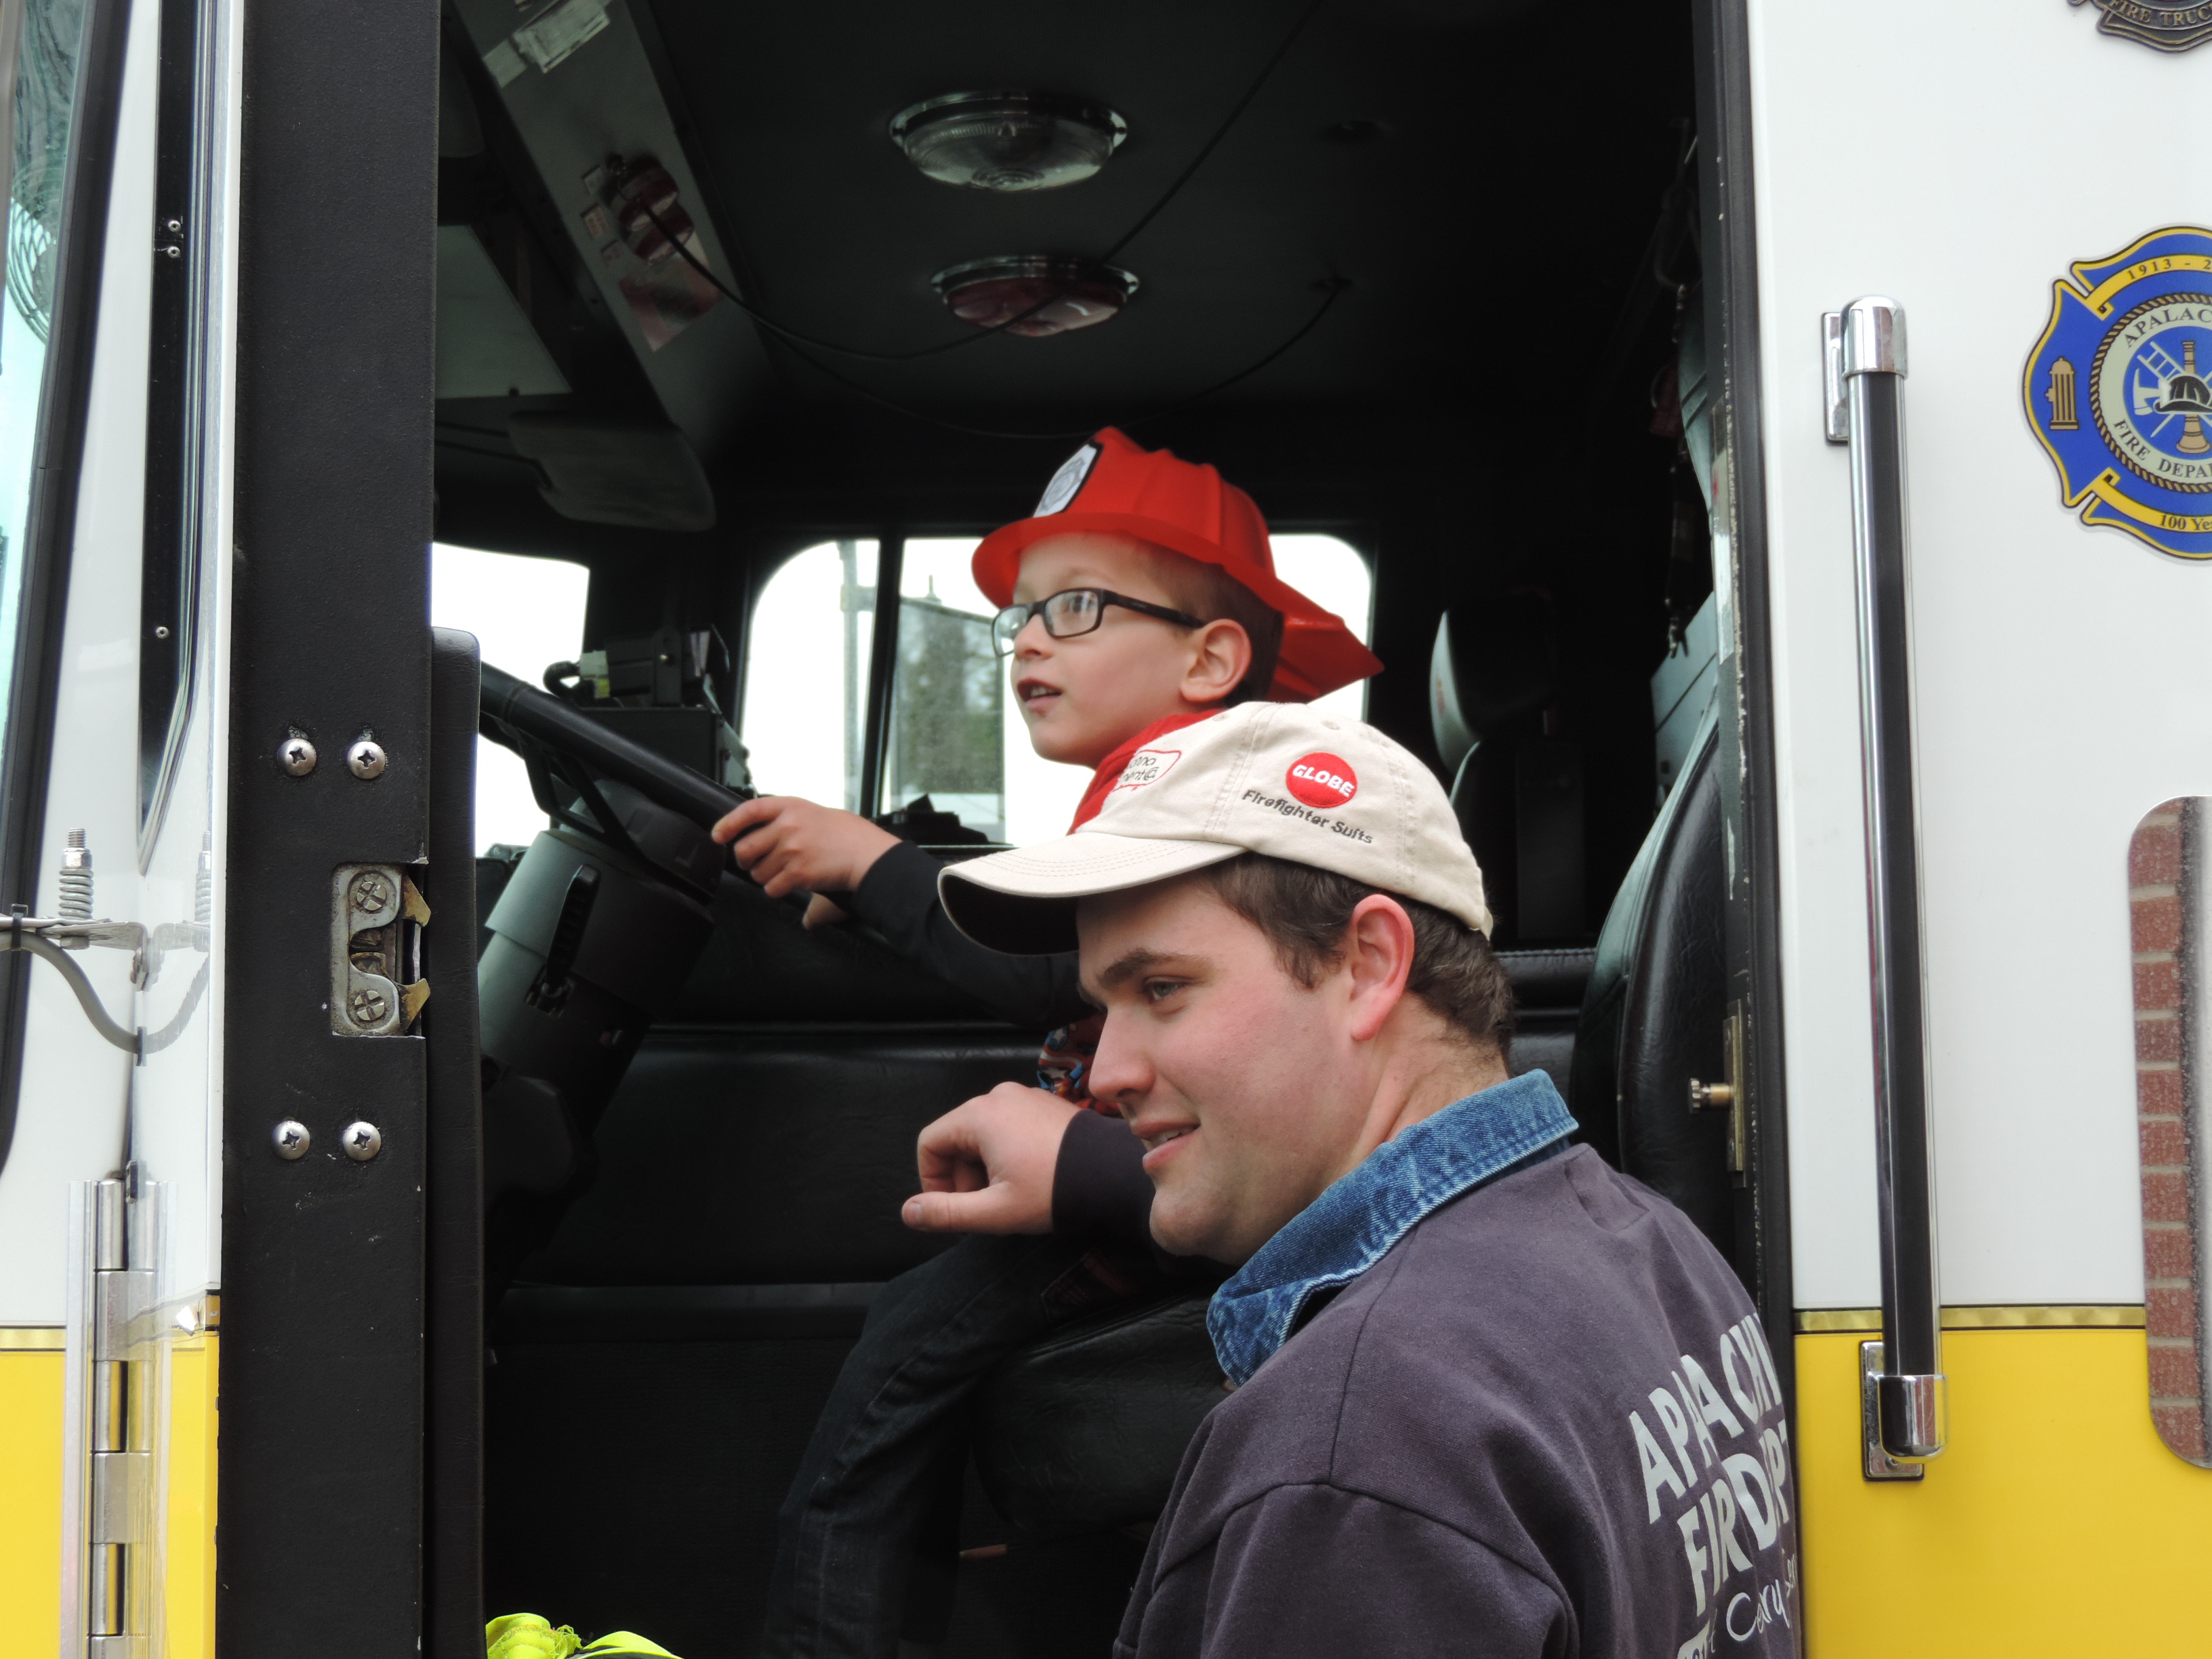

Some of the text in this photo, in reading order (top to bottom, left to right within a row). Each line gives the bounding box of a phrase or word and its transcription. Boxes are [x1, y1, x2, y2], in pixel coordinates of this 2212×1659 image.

[2109, 0, 2212, 26] FIRE TRUC
[2127, 258, 2172, 280] 1913
[2114, 419, 2151, 462] FIRE
[2160, 514, 2212, 531] 100 Ye
[1292, 764, 1354, 797] GLOBE
[1242, 790, 1374, 844] Firefighter Suits
